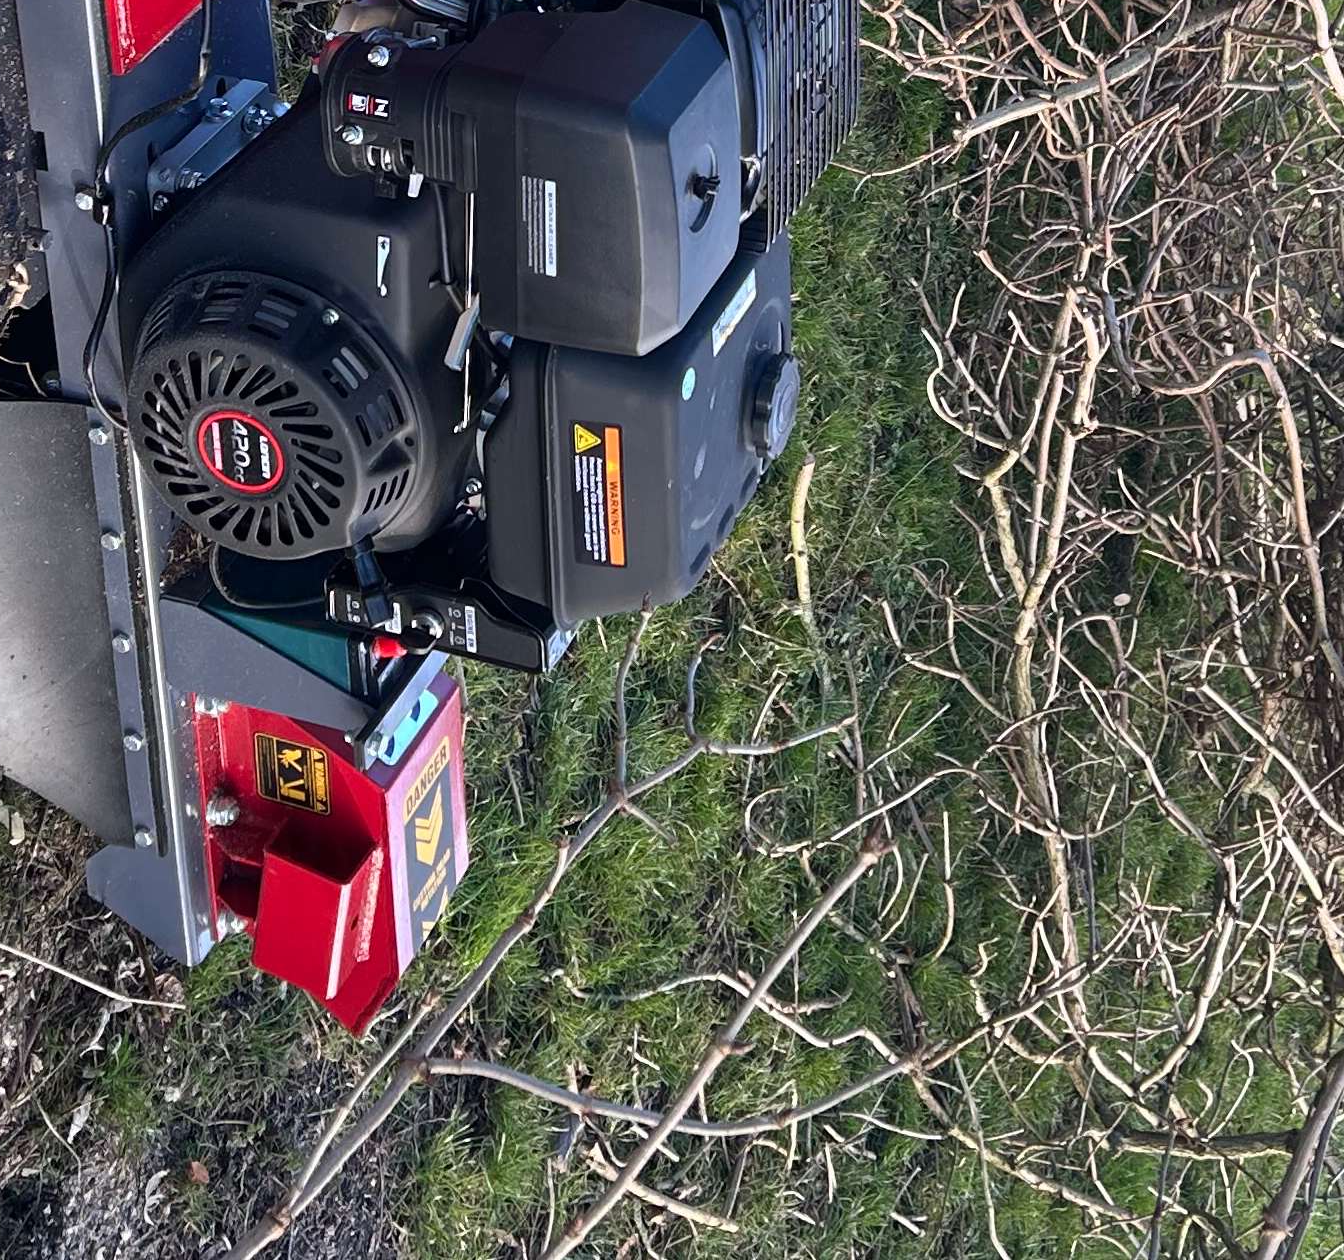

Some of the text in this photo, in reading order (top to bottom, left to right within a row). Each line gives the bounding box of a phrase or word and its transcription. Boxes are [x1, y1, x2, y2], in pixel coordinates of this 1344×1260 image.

[231, 420, 251, 483] 420cc
[609, 480, 621, 536] WARNING
[315, 762, 326, 802] WARNING
[406, 745, 447, 817] DANGER
